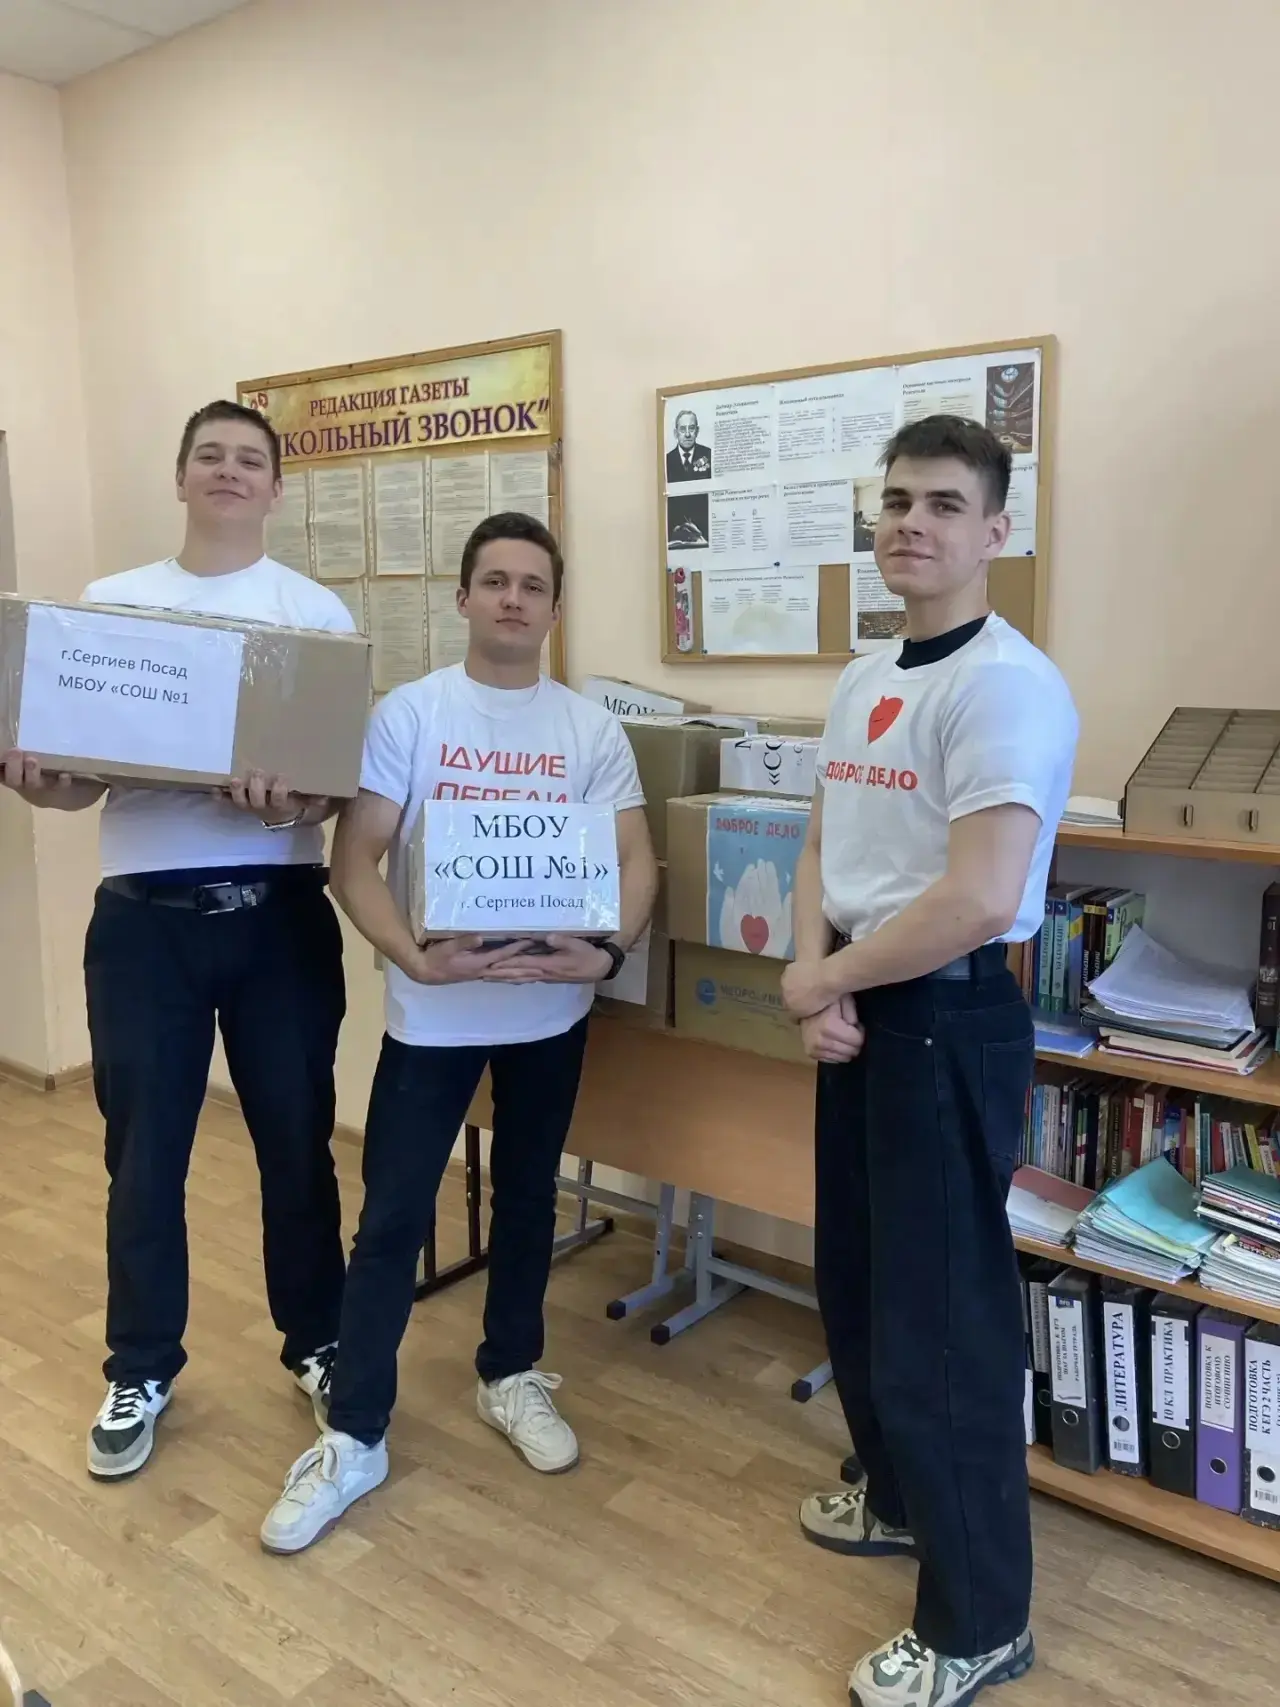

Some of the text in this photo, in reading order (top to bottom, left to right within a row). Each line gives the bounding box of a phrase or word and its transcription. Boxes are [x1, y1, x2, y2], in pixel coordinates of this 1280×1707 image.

[310, 377, 469, 417] РЕДАКЦИЯ ГАЗЕТЫ
[277, 411, 410, 458] КОЛЬНЫЙ
[61, 649, 188, 679] г.Сергиев Посад
[58, 674, 189, 705] МБОУ «СОШ №1
[866, 766, 918, 791] ДЕЛО
[472, 814, 569, 839] МБОУ
[716, 818, 801, 840] ДОБРОЕ ДЕЛО
[434, 855, 534, 880] «СОШ
[475, 894, 535, 911] Сергиев
[540, 894, 584, 909] Посад
[1111, 1311, 1128, 1412] ЛИТЕРАТУРА
[1163, 1320, 1174, 1421] 10 КЛ ПРАКТИКА
[1204, 1355, 1212, 1409] ПОДГОТОВКА
[1262, 1360, 1271, 1394] ЧАСТЬ
[1249, 1360, 1259, 1432] ПОДГОТОВКА
[1262, 1404, 1271, 1425] ЕГЭ
[1262, 1426, 1271, 1435] К
